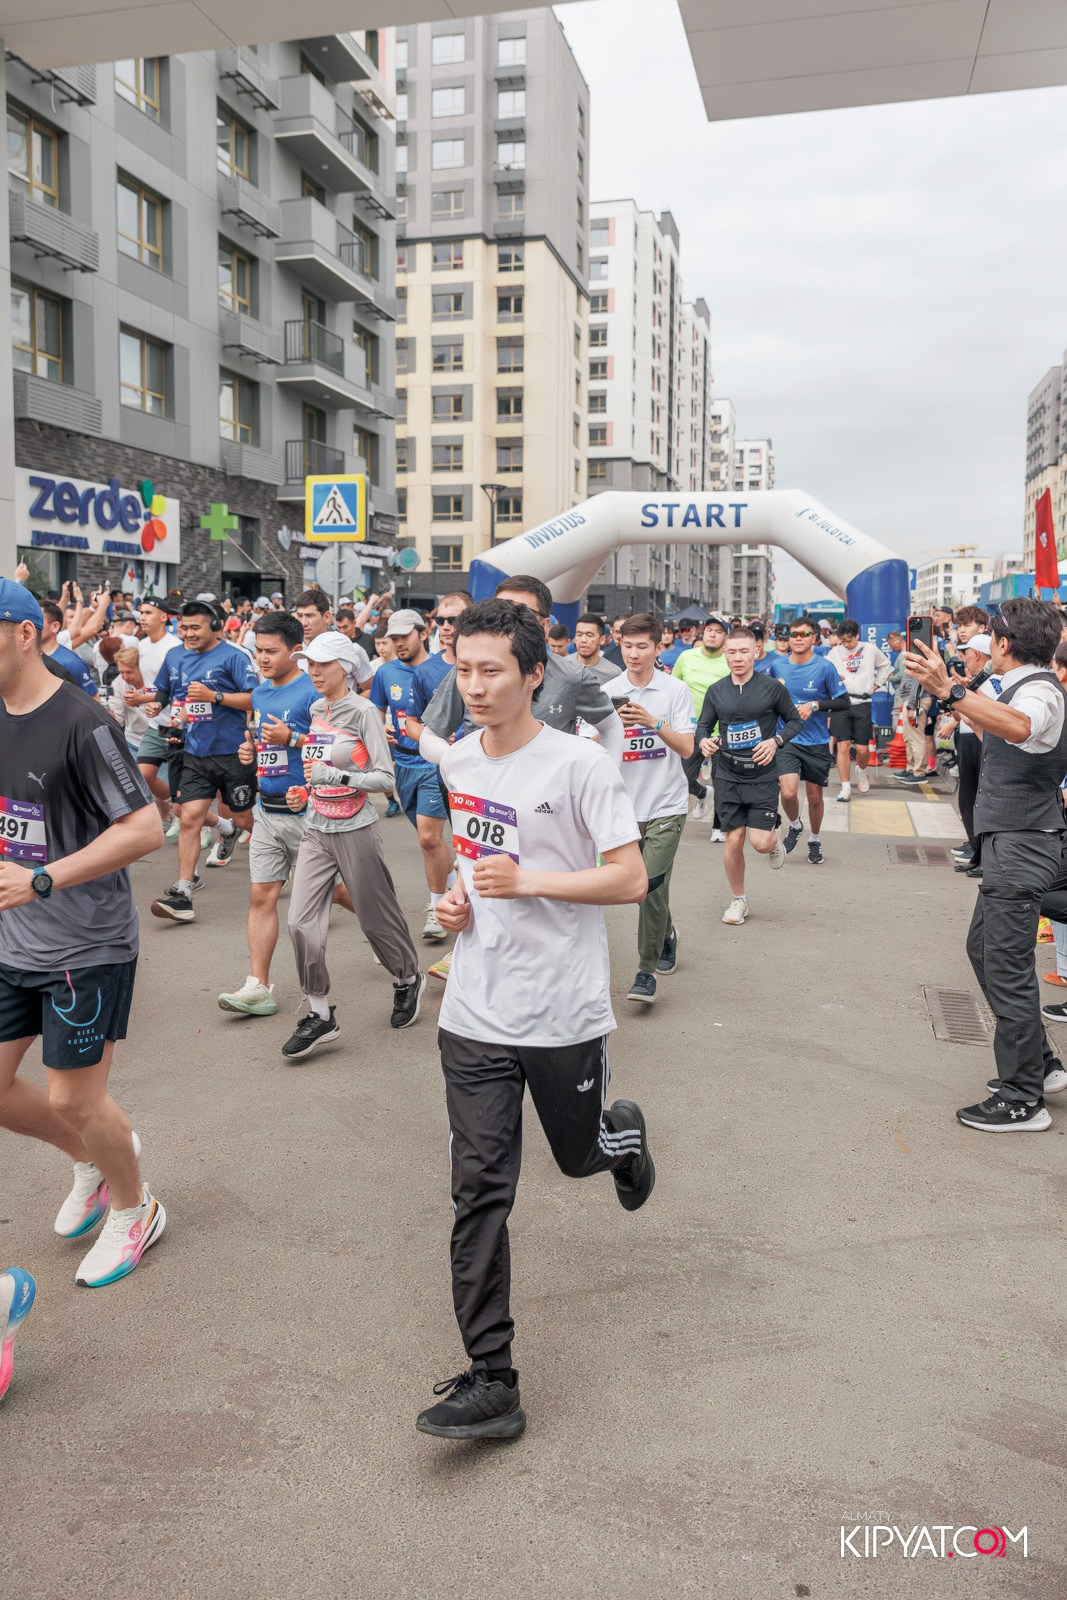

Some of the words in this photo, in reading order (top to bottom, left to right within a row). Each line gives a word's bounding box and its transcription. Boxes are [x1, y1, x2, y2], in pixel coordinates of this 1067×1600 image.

[29, 476, 142, 533] zerde
[640, 503, 748, 528] START
[524, 511, 587, 549] INVICTUS
[190, 704, 206, 713] 455
[730, 729, 757, 742] 1385
[630, 737, 655, 750] 510
[260, 753, 278, 765] 379
[305, 746, 324, 759] 375
[107, 748, 136, 795] PUMA
[452, 795, 464, 804] 10
[465, 799, 476, 807] KM
[466, 816, 505, 847] 018
[77, 1027, 95, 1036] NIKE
[67, 1033, 105, 1045] RUNNING
